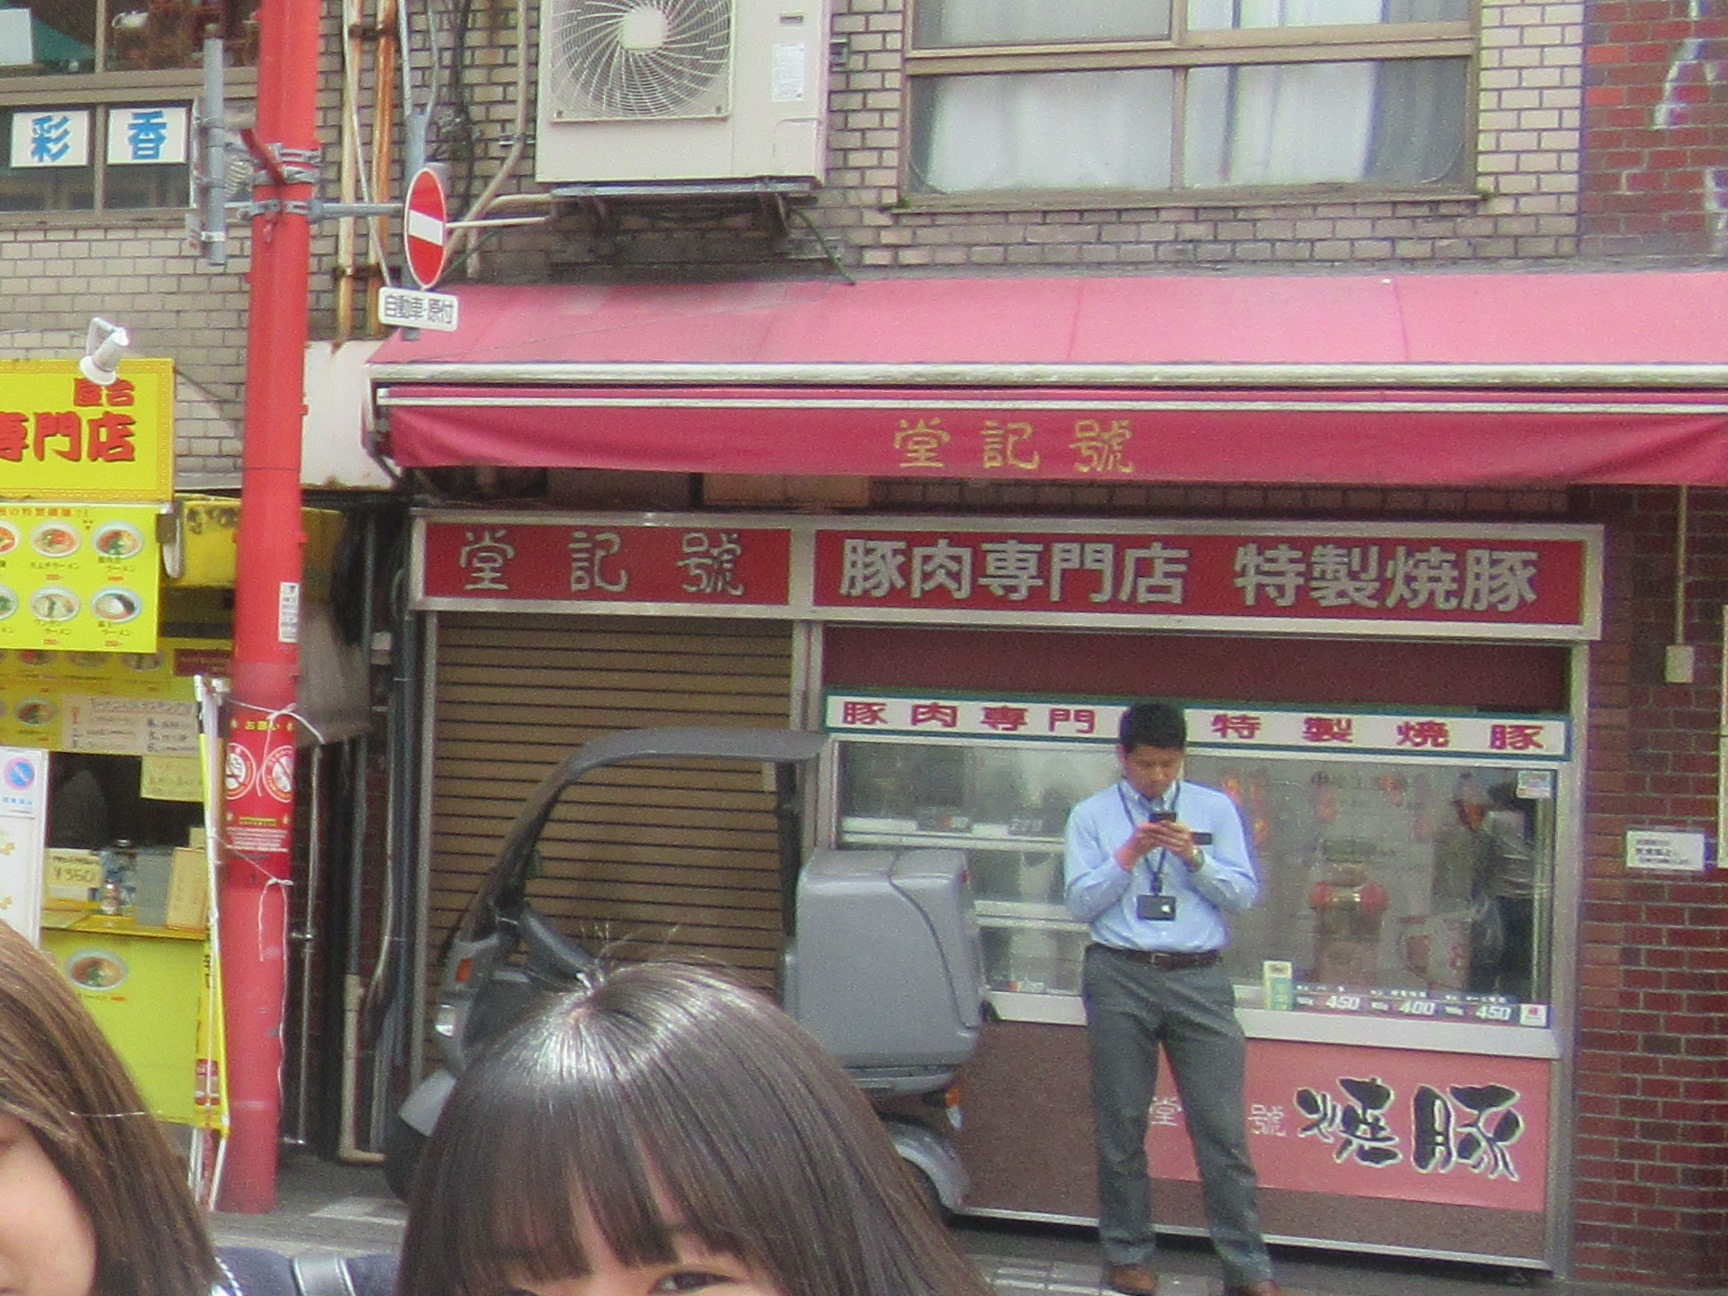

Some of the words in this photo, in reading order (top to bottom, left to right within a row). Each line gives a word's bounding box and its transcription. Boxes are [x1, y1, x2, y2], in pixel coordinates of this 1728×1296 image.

[30, 115, 72, 164] 彩
[128, 111, 168, 161] 香
[893, 418, 1136, 475] 堂記號
[458, 530, 745, 597] 堂記號
[840, 540, 1190, 604] 豚肉専門店
[1234, 542, 1540, 613] 特製焼豚
[1399, 1000, 1436, 1016] 400
